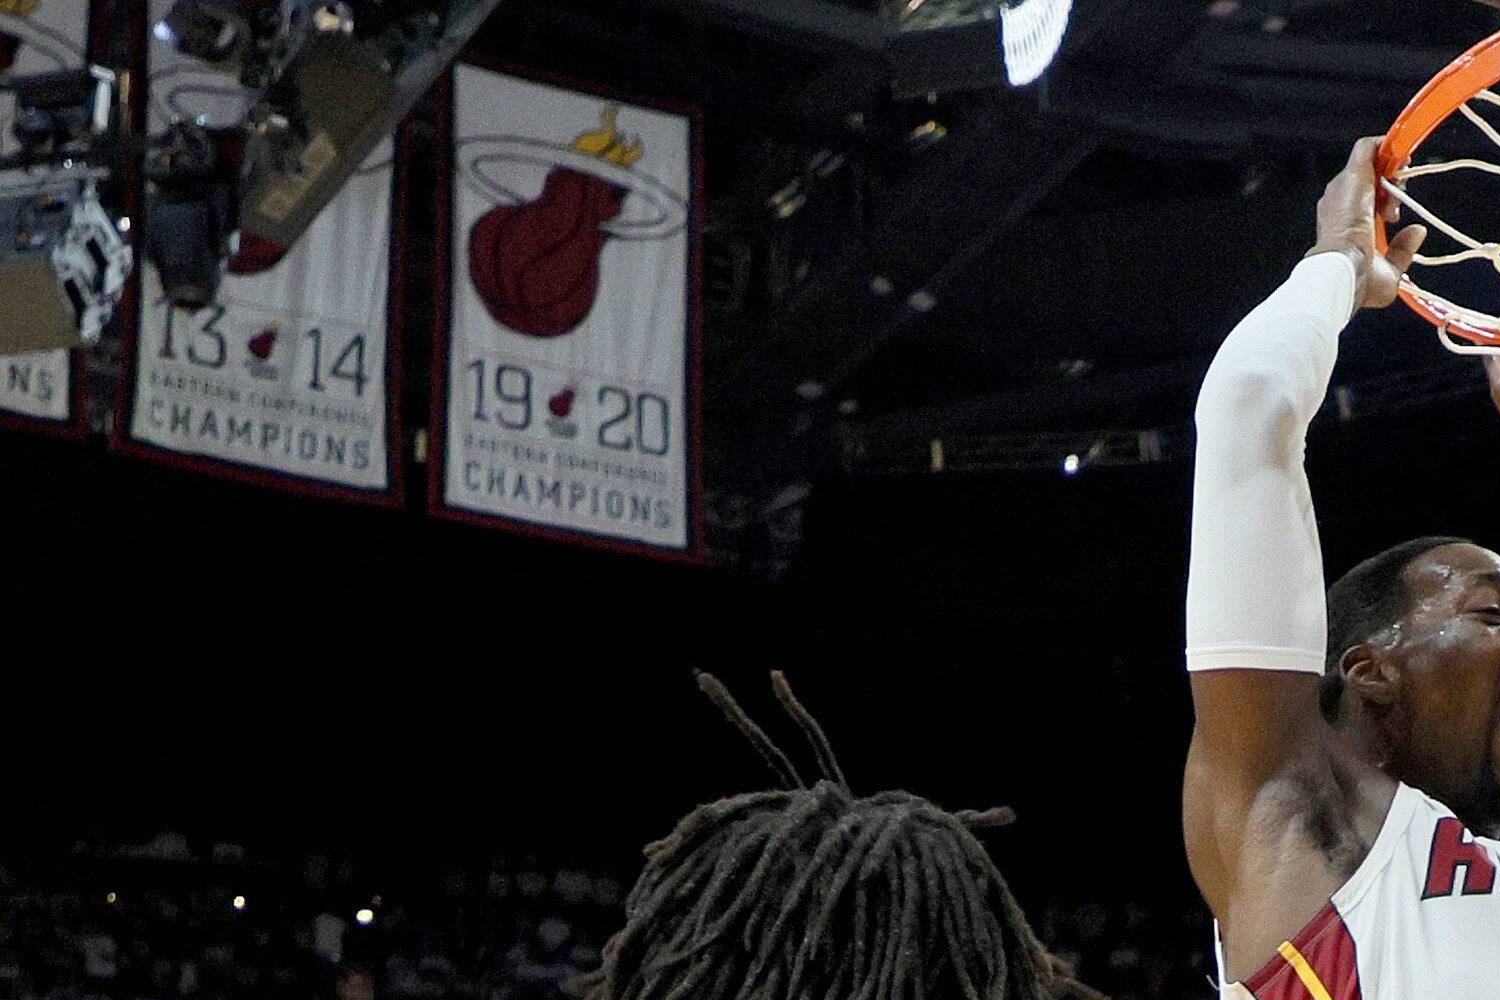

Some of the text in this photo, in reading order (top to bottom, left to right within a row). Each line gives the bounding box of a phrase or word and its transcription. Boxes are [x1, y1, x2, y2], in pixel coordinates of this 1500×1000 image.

[158, 299, 368, 397] 13 14
[150, 399, 371, 470] CHAMPIONS
[462, 358, 670, 457] 19 20
[463, 460, 673, 529] CHAMPIONS
